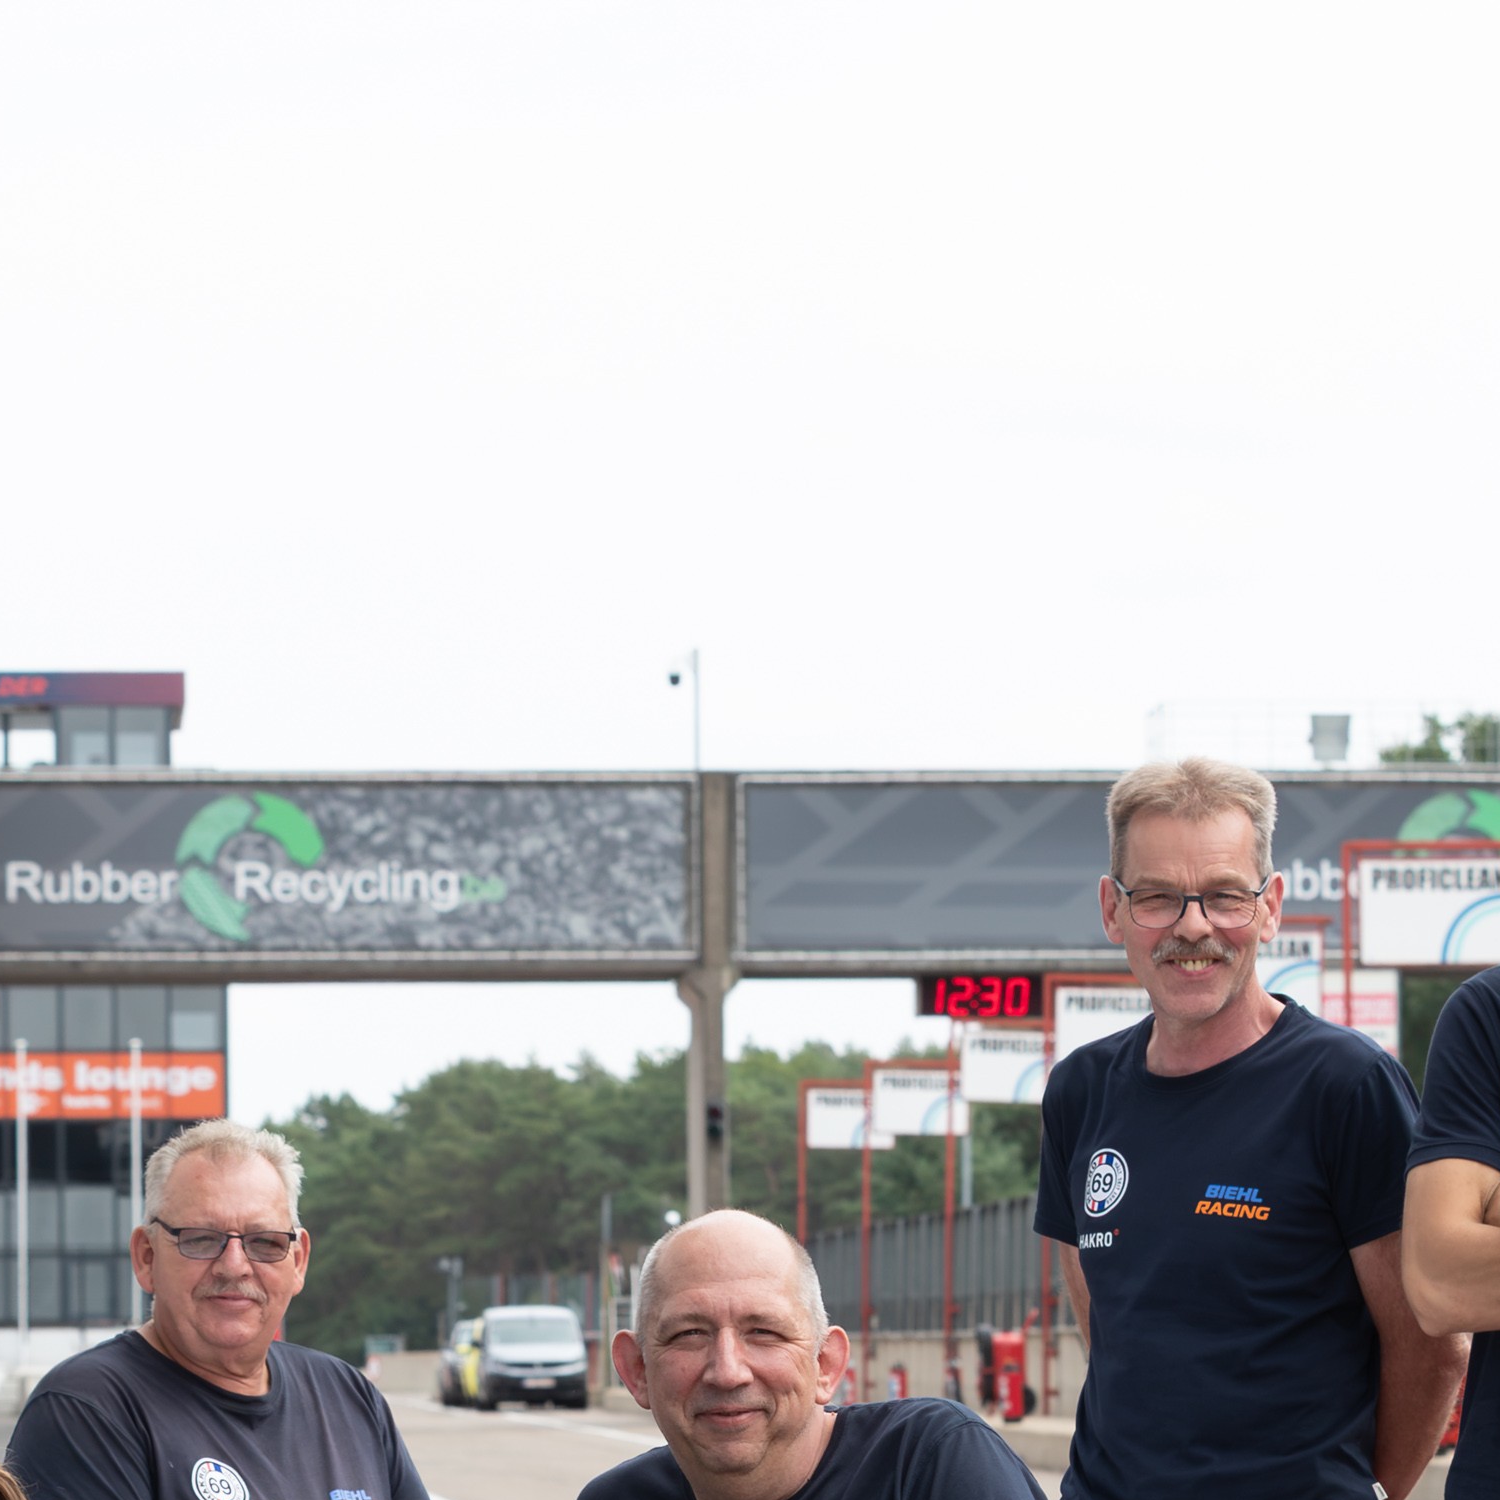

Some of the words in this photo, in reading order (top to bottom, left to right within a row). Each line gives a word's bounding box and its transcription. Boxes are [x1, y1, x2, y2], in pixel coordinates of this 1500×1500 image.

[5, 860, 179, 903] Rubber
[933, 976, 1032, 1017] 12:30
[1091, 1172, 1114, 1193] 69
[1204, 1184, 1263, 1203] BIEHL
[1195, 1200, 1271, 1221] RACING
[1079, 1231, 1113, 1250] HAKRO
[209, 1477, 232, 1495] 69
